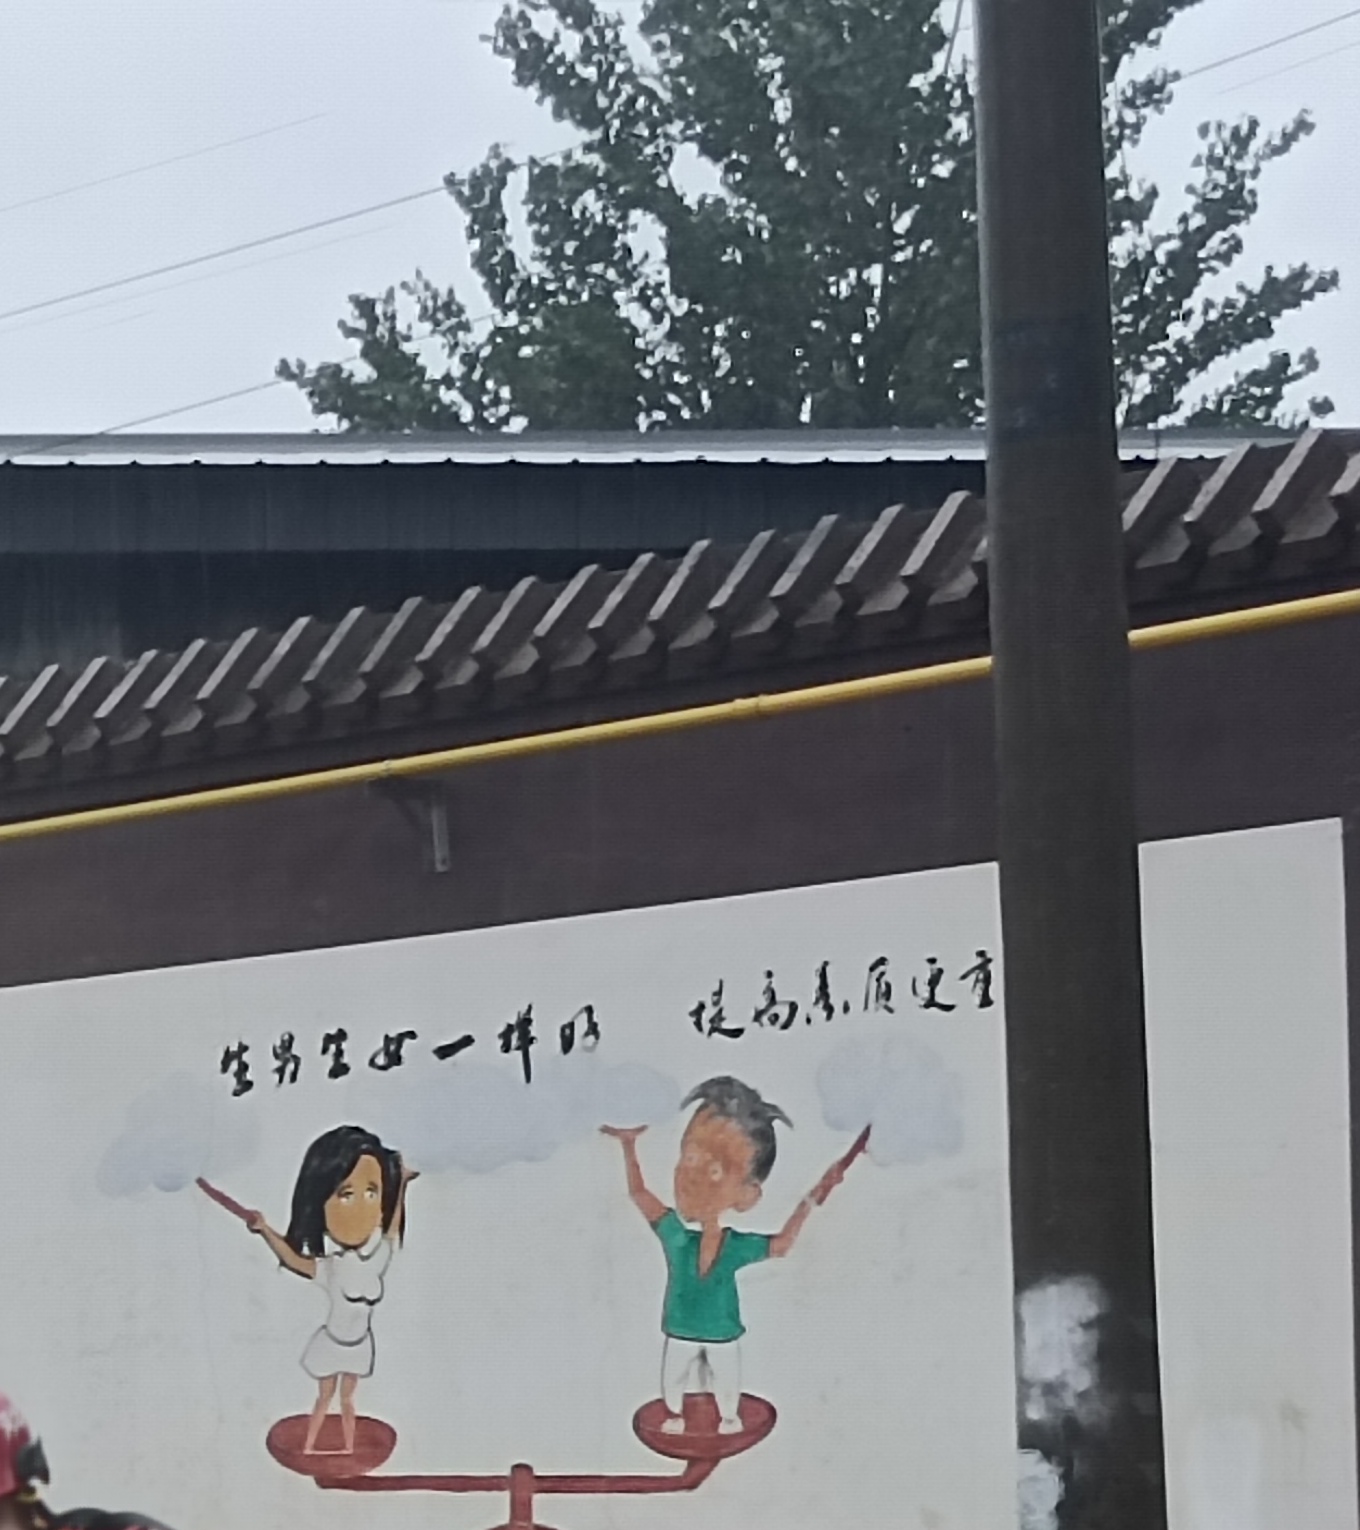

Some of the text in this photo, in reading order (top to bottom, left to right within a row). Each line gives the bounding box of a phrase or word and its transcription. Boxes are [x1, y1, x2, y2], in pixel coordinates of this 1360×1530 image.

[220, 1003, 600, 1097] 生男生女一样好
